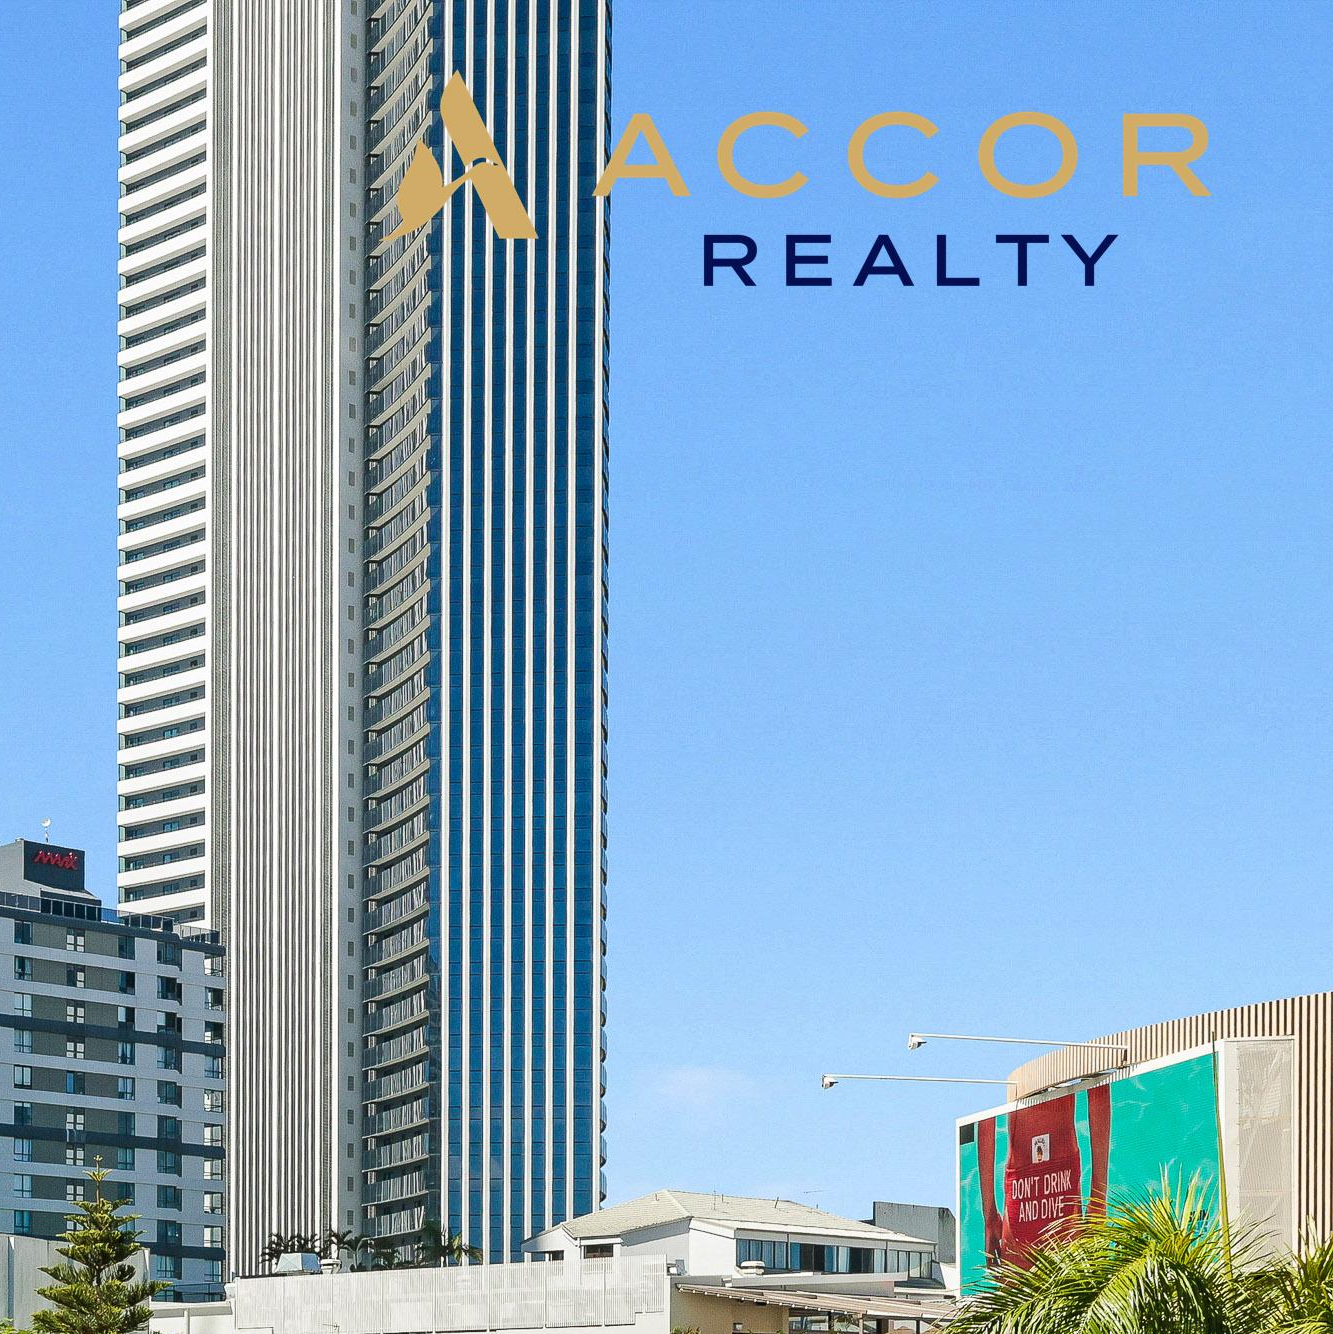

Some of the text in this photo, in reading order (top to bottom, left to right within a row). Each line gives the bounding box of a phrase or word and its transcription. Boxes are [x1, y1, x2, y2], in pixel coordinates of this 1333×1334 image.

[1011, 1169, 1072, 1200] DON'T DRINK
[1018, 1195, 1065, 1223] AND DIVE
